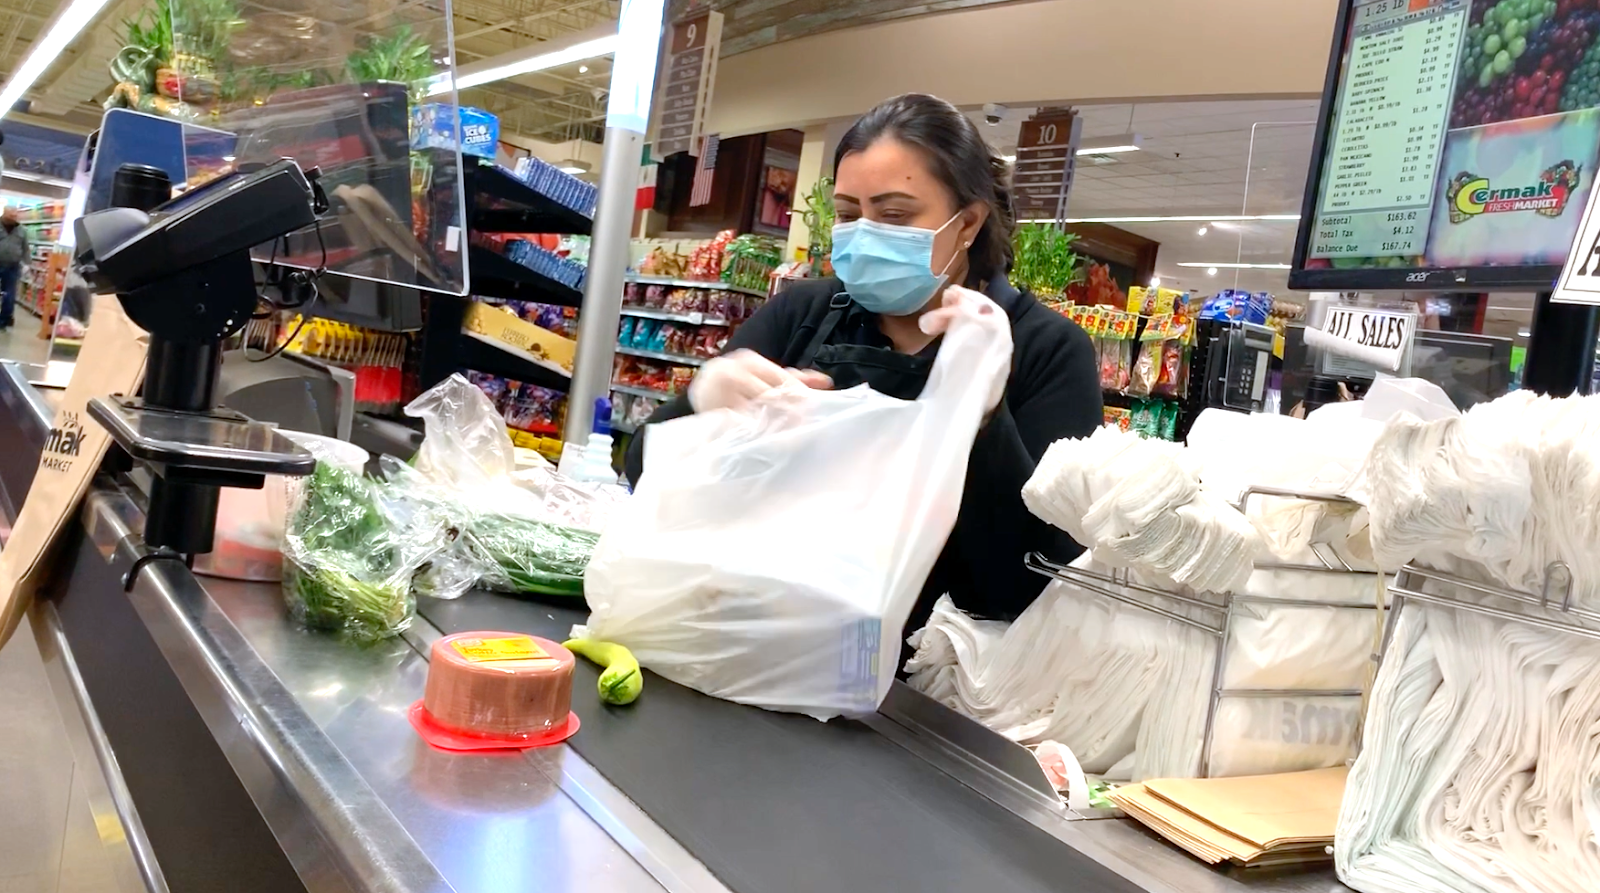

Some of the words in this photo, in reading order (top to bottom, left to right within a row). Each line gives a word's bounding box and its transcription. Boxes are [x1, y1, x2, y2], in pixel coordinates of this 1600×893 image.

[1365, 3, 1387, 17] 1.25
[686, 24, 696, 48] 9
[1037, 124, 1057, 145] 10
[1455, 178, 1554, 215] Cermak
[1321, 216, 1352, 226] Subtotal
[1387, 212, 1417, 222] $163.62
[1319, 230, 1338, 238] Total
[1342, 230, 1354, 238] Tax
[1393, 226, 1415, 235] $4.12
[1316, 244, 1343, 253] Balance
[1346, 244, 1359, 252] Due
[1381, 242, 1412, 251] $167.74
[1405, 271, 1430, 282] acer
[1357, 314, 1405, 350] SALES
[41, 457, 73, 472] MARKET
